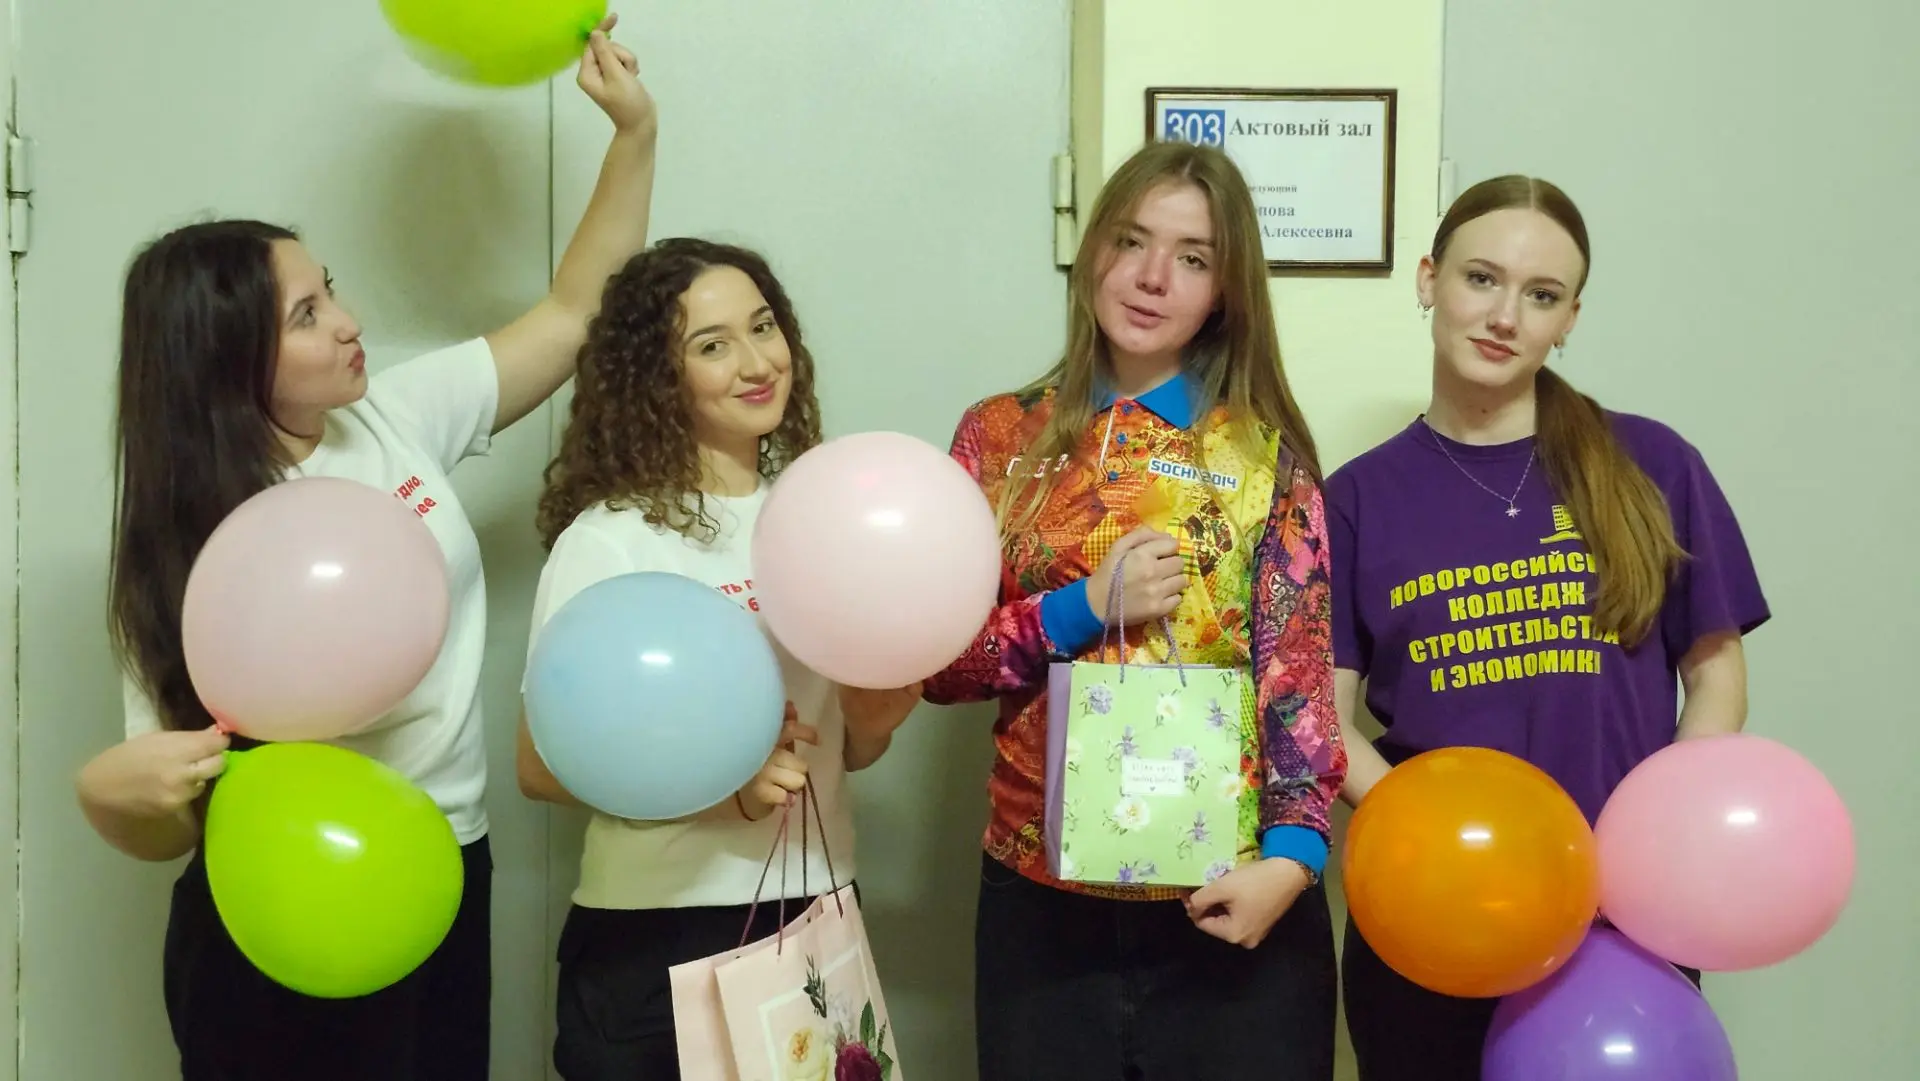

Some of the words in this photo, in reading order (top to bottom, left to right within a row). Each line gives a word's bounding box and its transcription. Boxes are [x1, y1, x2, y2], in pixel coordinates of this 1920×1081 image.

[1167, 112, 1222, 147] 303
[1229, 117, 1330, 137] Актовый
[1337, 122, 1373, 137] зал
[1255, 206, 1295, 217] пова
[1261, 224, 1353, 239] Алексеевна
[1151, 459, 1197, 480] SOCHI
[1201, 470, 1237, 489] 2014
[393, 475, 425, 500] дно,
[1448, 581, 1586, 622] КОЛЛЕДЖ
[1430, 668, 1446, 692] И
